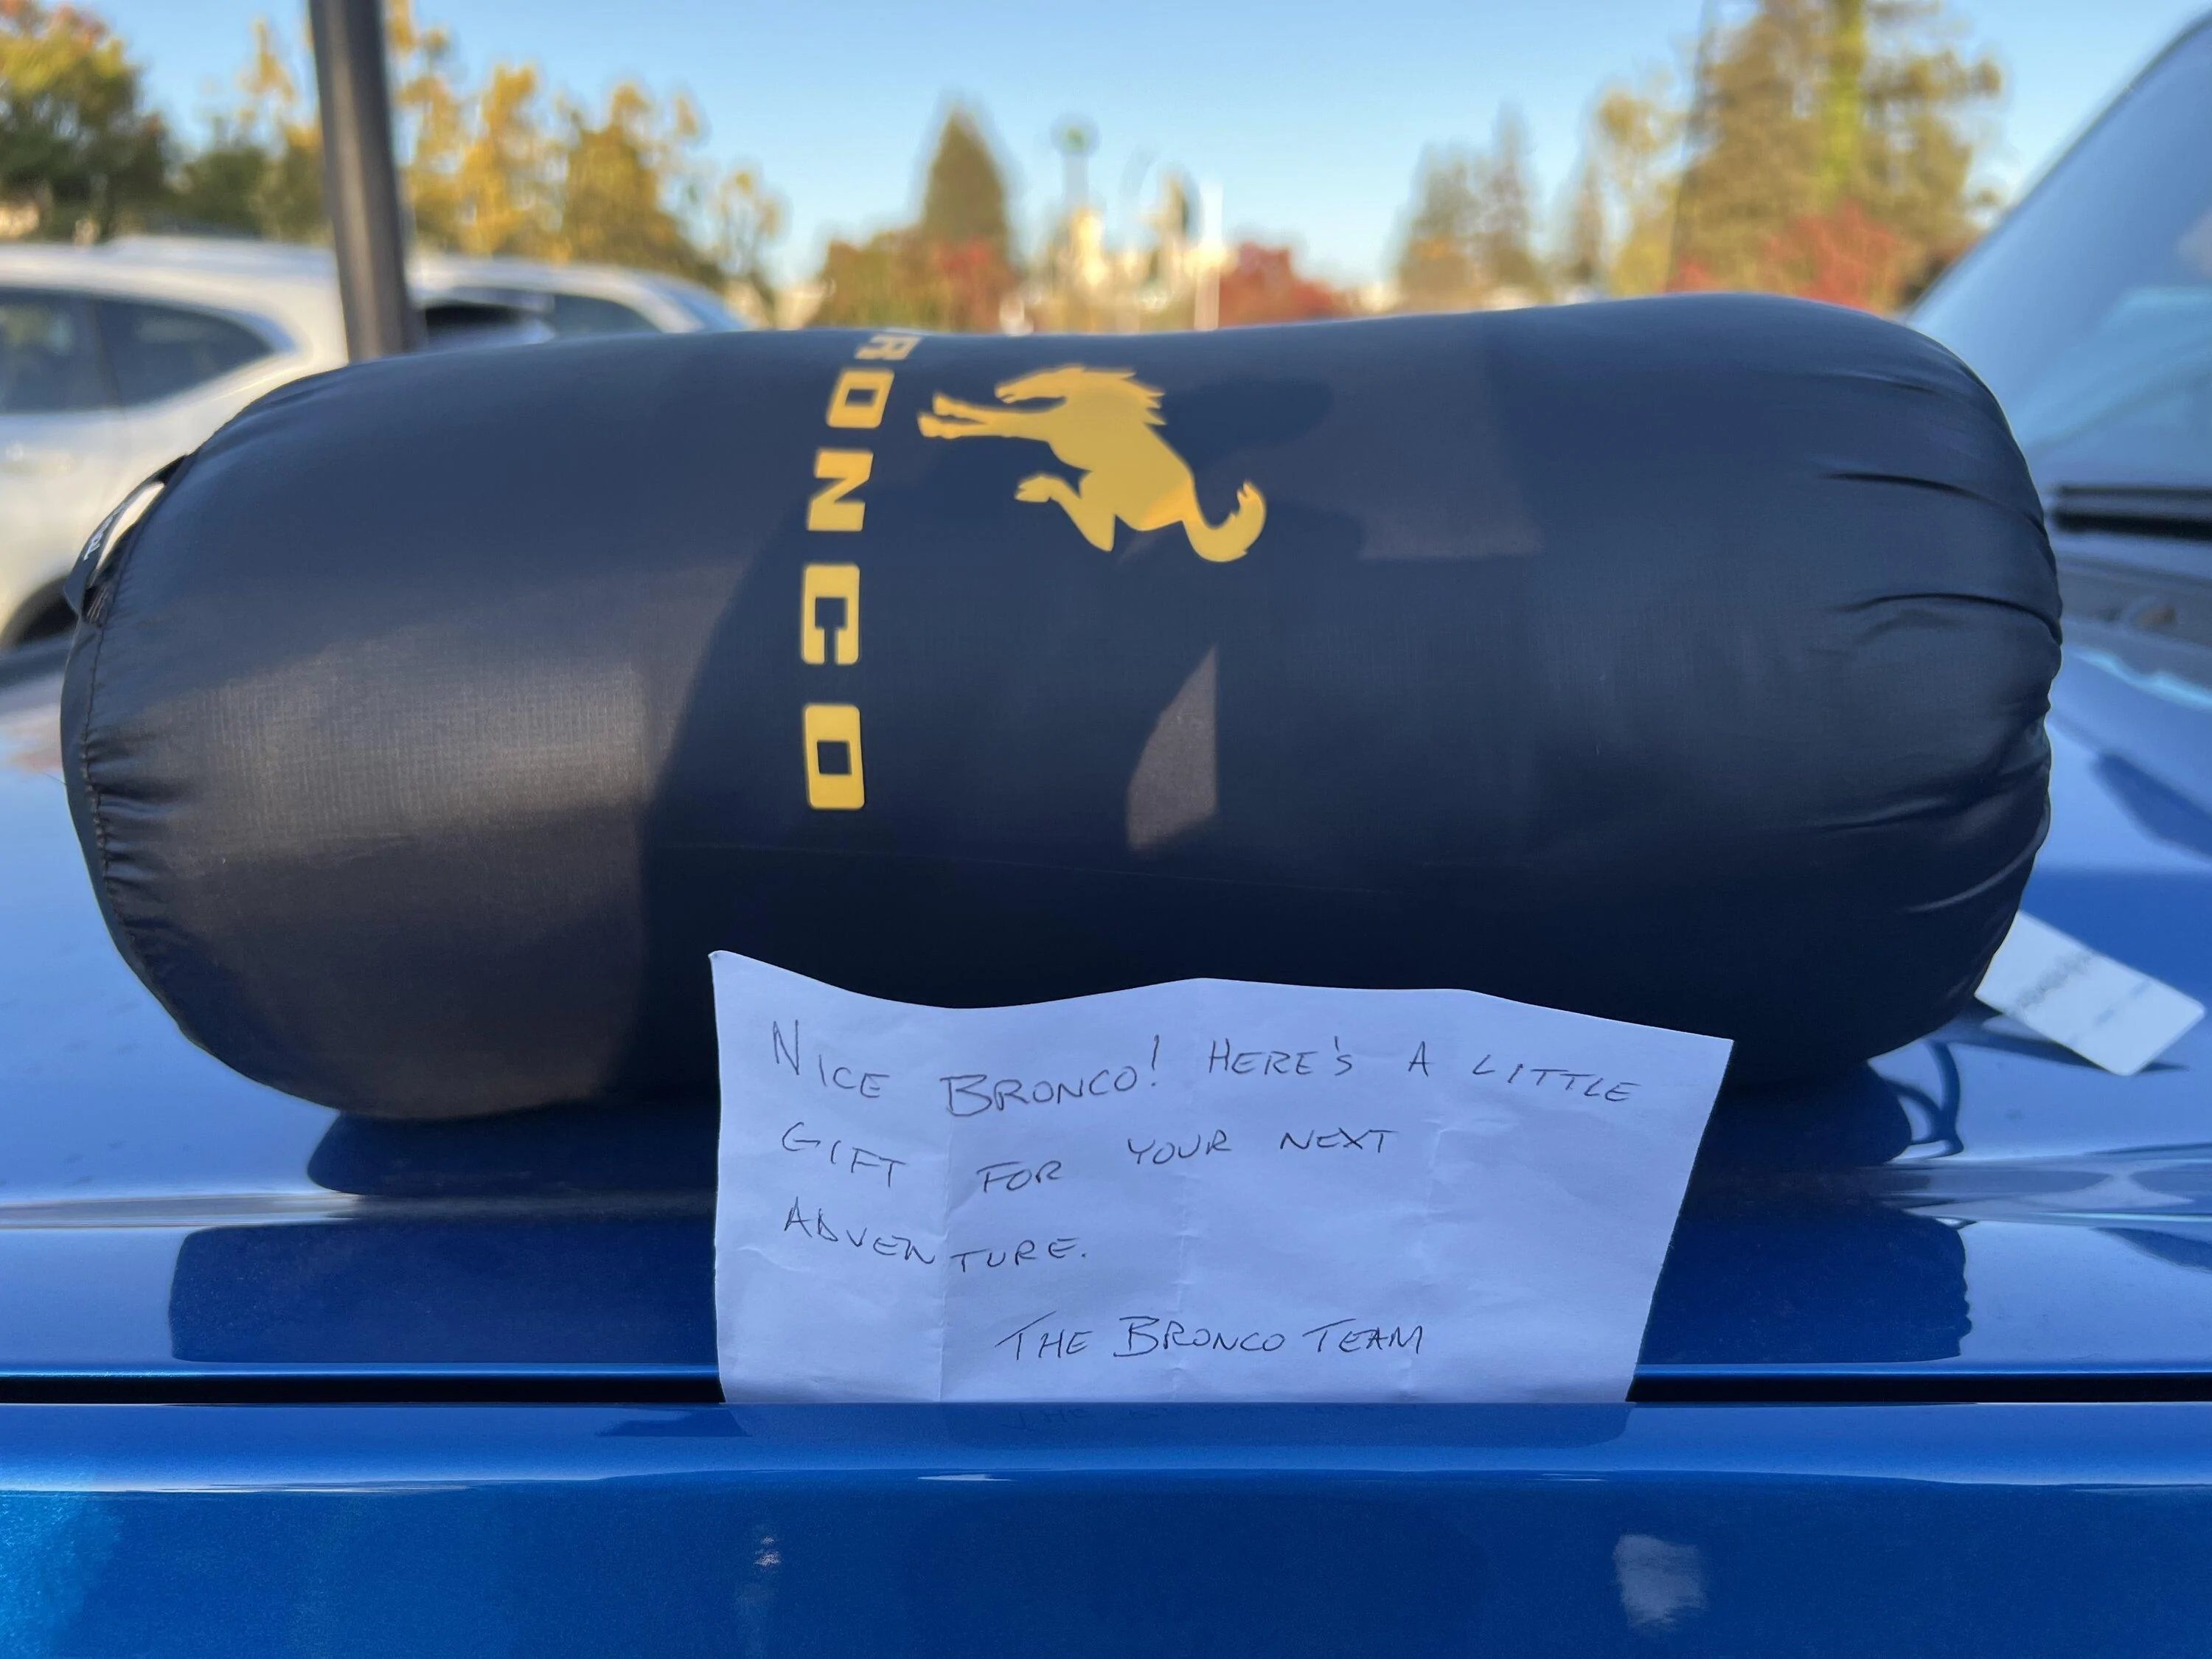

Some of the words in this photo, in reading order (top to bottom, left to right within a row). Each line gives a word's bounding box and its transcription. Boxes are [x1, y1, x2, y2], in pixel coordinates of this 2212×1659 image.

[801, 334, 923, 810] RONCO
[772, 1019, 891, 1099] NICE
[939, 1034, 1160, 1118] BRONCO!
[1208, 1035, 1354, 1077] HERE'S
[1407, 1040, 1433, 1077] A
[1472, 1054, 1641, 1103] LITTLE
[782, 1121, 907, 1189] GIFT
[975, 1160, 1062, 1194] FOR
[1127, 1129, 1232, 1165] YOUR
[1279, 1127, 1398, 1155] NEXT
[783, 1195, 1087, 1273] ADVENTURE.
[994, 1310, 1093, 1362] THE
[1113, 1315, 1286, 1358] BRONCO
[1302, 1318, 1424, 1355] TEAM
